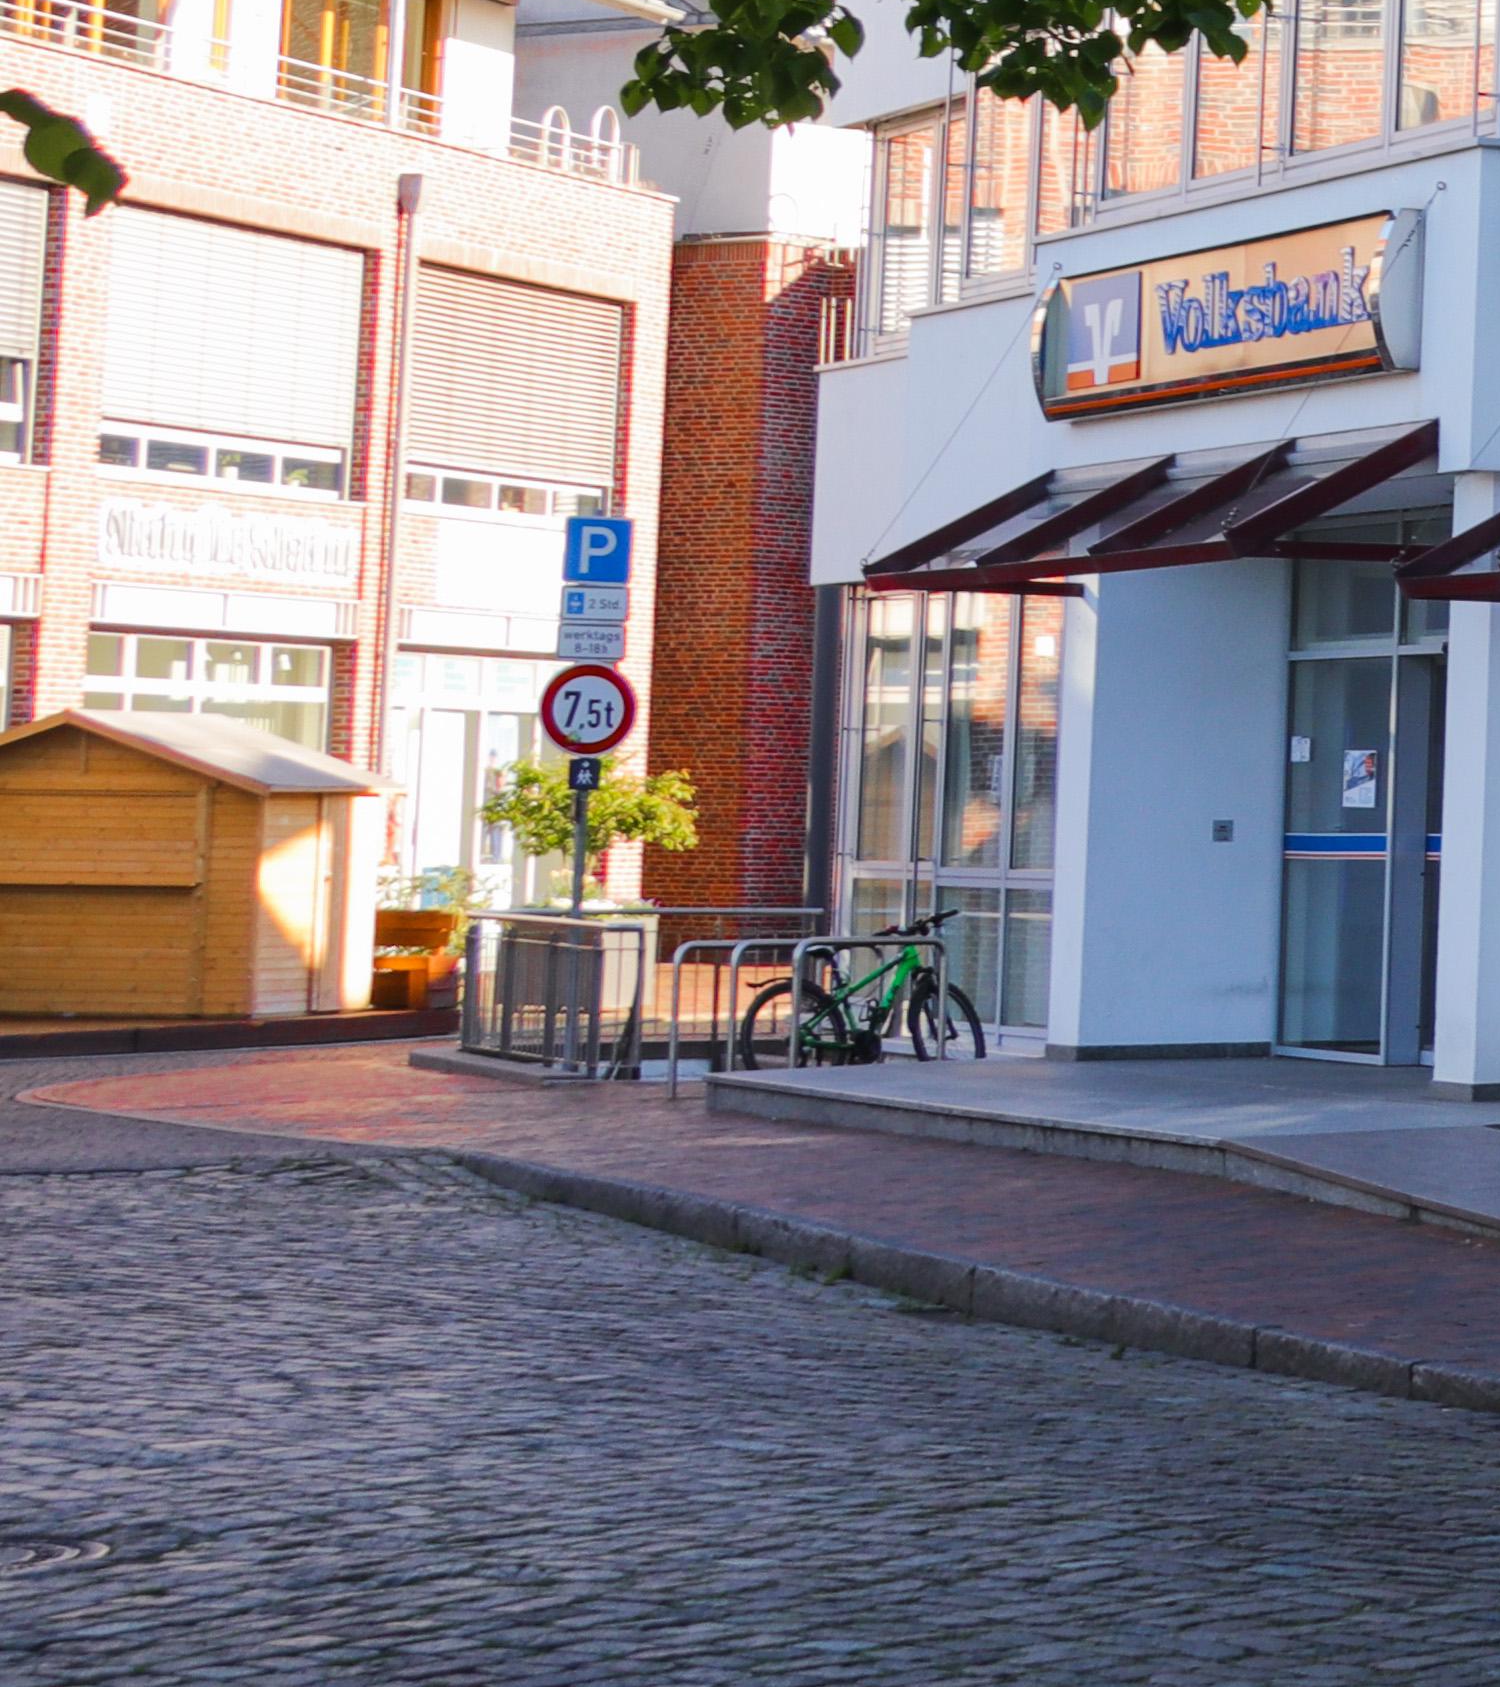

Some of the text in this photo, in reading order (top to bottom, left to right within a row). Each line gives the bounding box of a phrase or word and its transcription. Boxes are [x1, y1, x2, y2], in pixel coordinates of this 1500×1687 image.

[1156, 245, 1370, 355] Volksbank
[578, 525, 617, 574] P
[588, 598, 623, 610] 2 Std.
[564, 631, 621, 644] werktags
[563, 690, 615, 730] 7,5t
